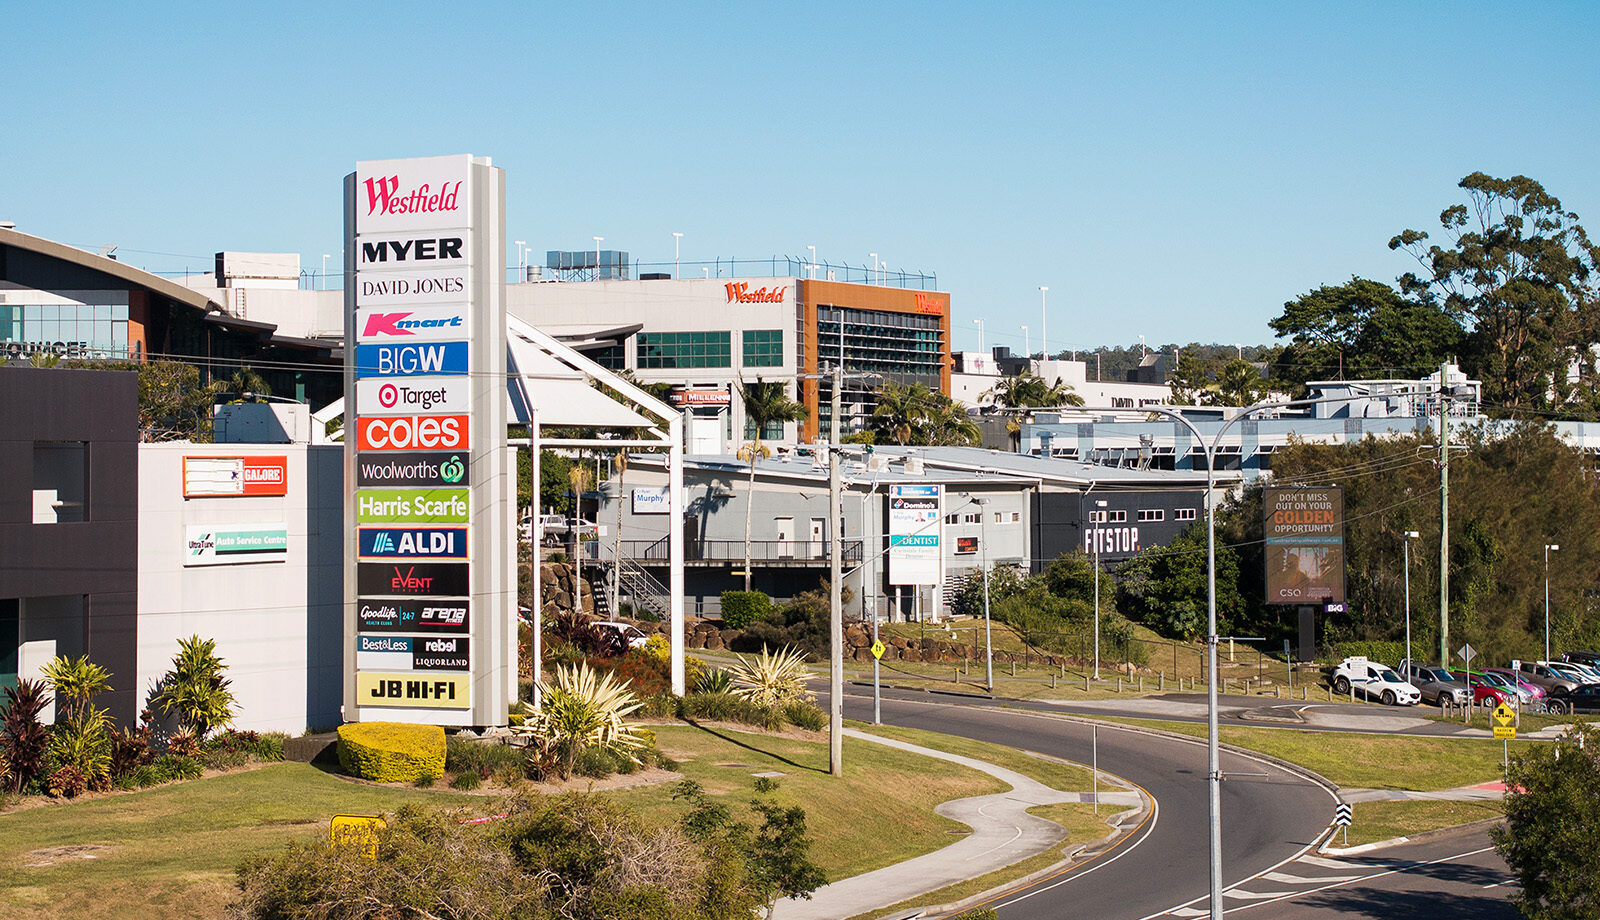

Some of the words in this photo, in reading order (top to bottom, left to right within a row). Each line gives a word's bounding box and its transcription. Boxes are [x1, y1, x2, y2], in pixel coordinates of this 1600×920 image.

[362, 174, 464, 217] Westfield
[362, 237, 463, 263] MYER
[362, 279, 409, 297] DAVID
[413, 276, 464, 295] JONES
[724, 281, 788, 304] Westfield
[914, 292, 944, 314] Westfield
[362, 312, 463, 337] Kmart
[400, 386, 447, 409] Target
[366, 416, 460, 449] coles
[244, 468, 280, 481] GALORE
[362, 461, 438, 480] Woolworths
[359, 496, 410, 516] Harris
[414, 495, 467, 516] Scarfe
[637, 494, 665, 503] Murphy
[903, 501, 935, 509] Domino's
[1280, 493, 1304, 502] DON'T
[1306, 493, 1328, 501] MISS
[1275, 502, 1293, 510] OUT
[1294, 502, 1306, 510] ON
[1309, 502, 1332, 510] YOUR
[1274, 510, 1334, 524] GOLDEN
[1274, 524, 1334, 532] OPPORTUNITY
[216, 537, 235, 545] Auto
[236, 535, 262, 545] Service
[264, 535, 286, 544] Centre
[398, 532, 454, 554] ALDI
[902, 537, 937, 545] DENTIST
[391, 566, 434, 588] EVENT
[421, 607, 467, 619] arena
[362, 637, 408, 651] Best&Less
[425, 639, 457, 652] rebel
[416, 658, 468, 667] LIQUORLAND
[371, 680, 402, 698] JB
